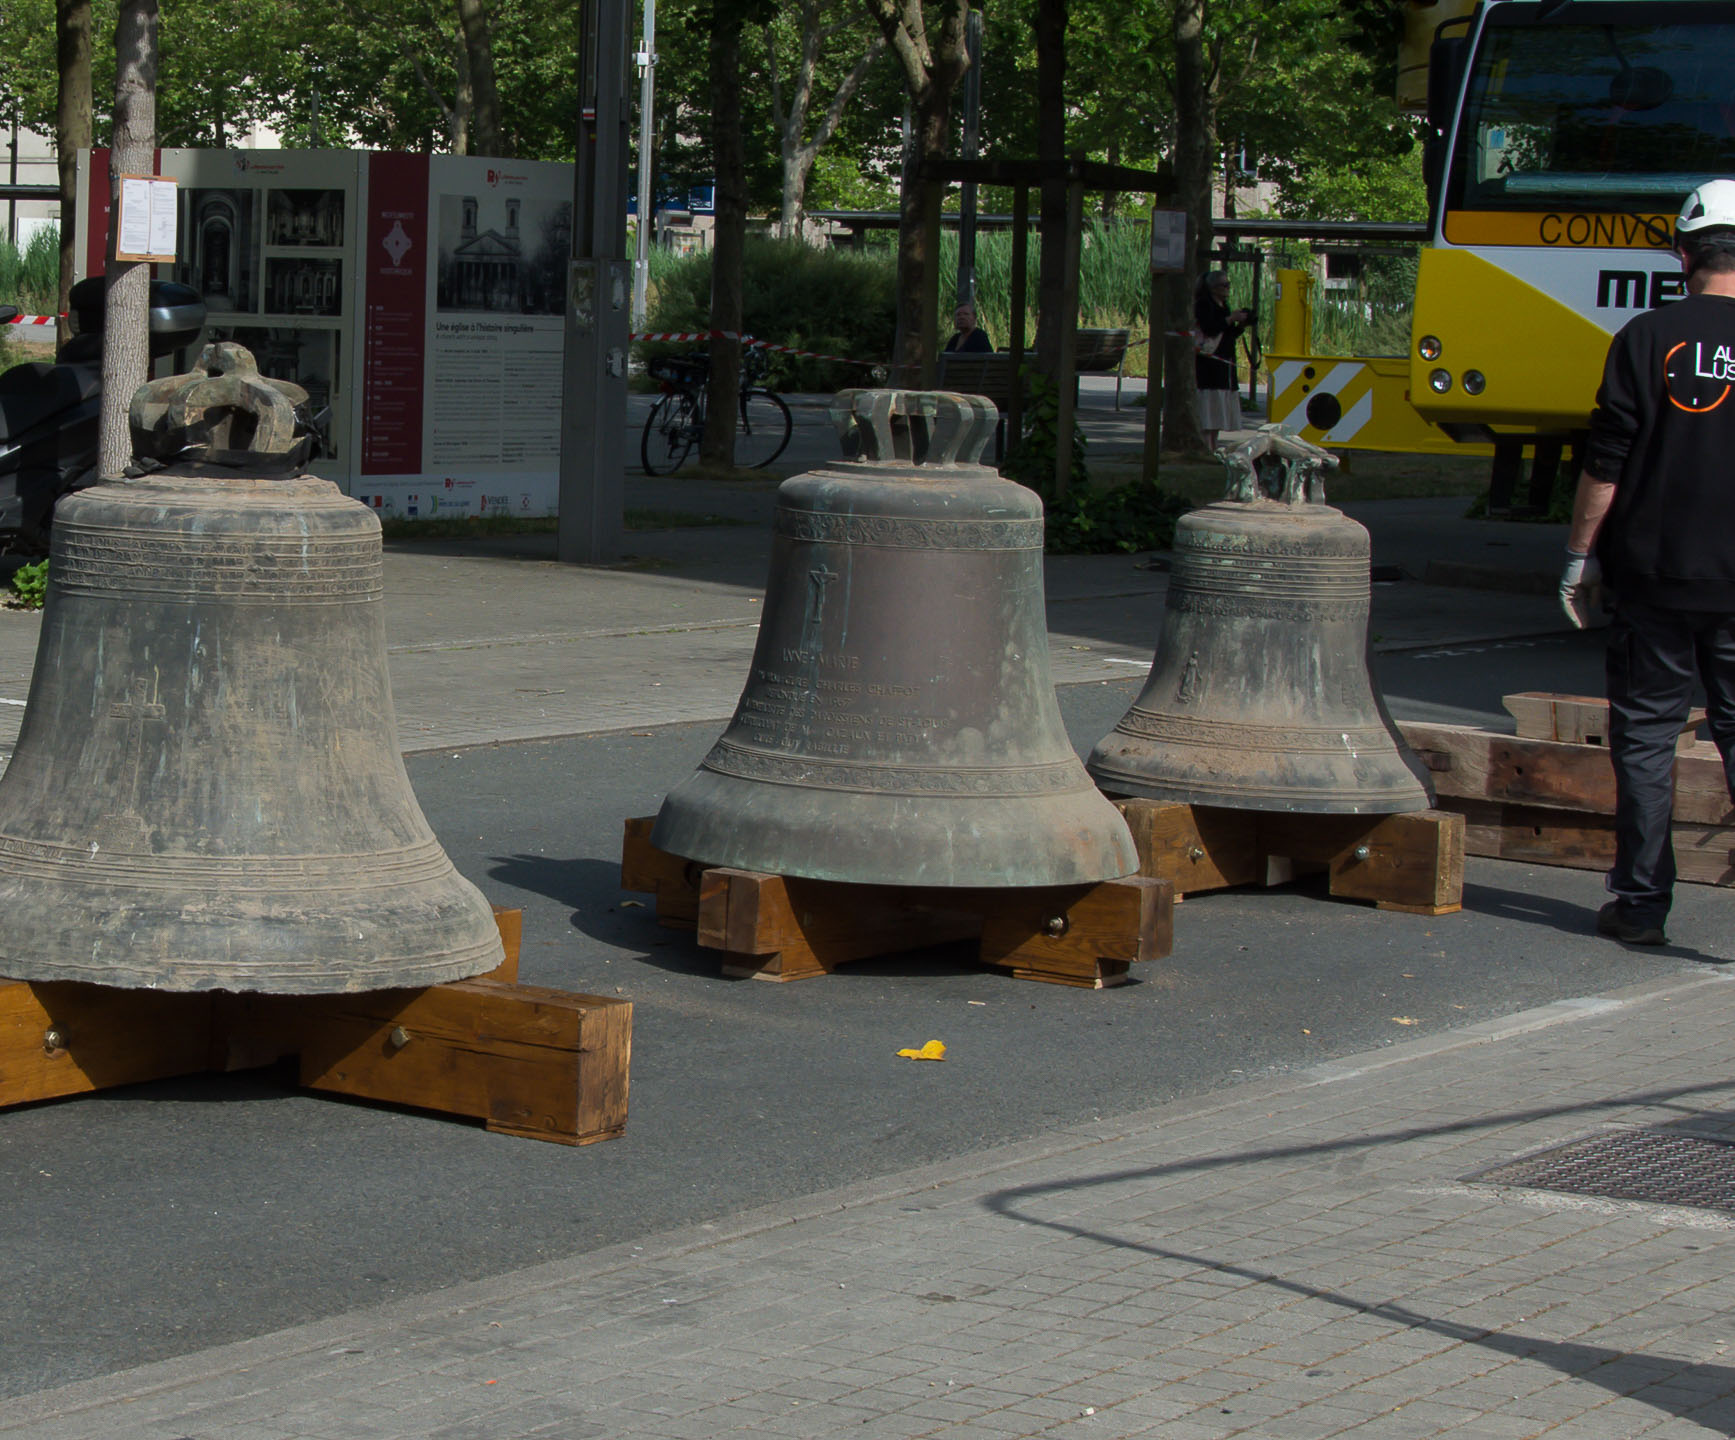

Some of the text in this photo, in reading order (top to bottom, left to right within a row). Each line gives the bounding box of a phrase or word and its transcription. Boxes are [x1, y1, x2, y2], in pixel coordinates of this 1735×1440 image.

[1539, 213, 1678, 247] CONVO
[1595, 269, 1688, 309] ME
[436, 322, 449, 331] Une
[451, 322, 469, 333] église
[504, 324, 534, 335] singulière
